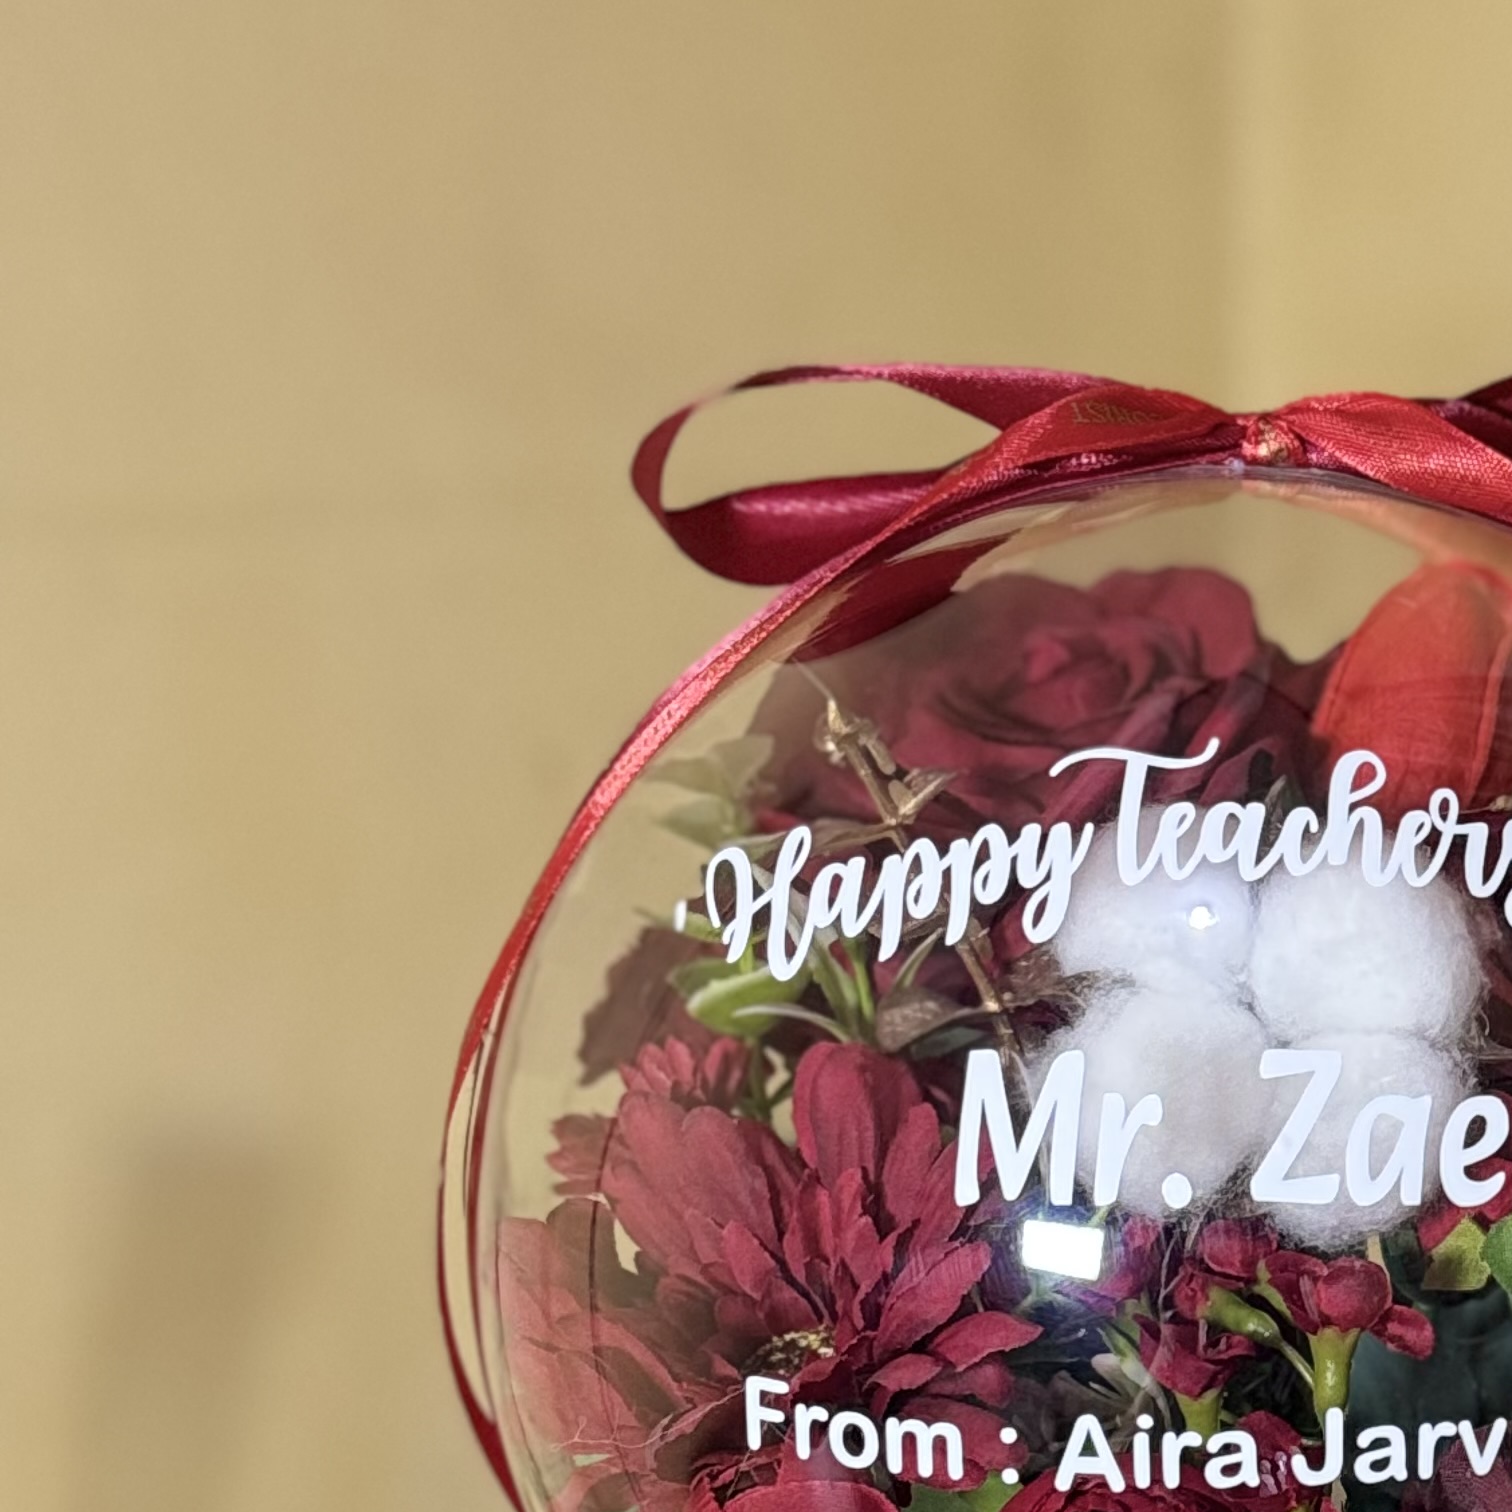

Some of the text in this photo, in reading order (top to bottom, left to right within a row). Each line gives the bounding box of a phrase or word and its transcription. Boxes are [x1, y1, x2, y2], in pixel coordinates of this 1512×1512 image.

[953, 1048, 1193, 1209] Mr.
[744, 1374, 965, 1482] From
[999, 1426, 1019, 1485] :
[1054, 1412, 1261, 1494] Aira
